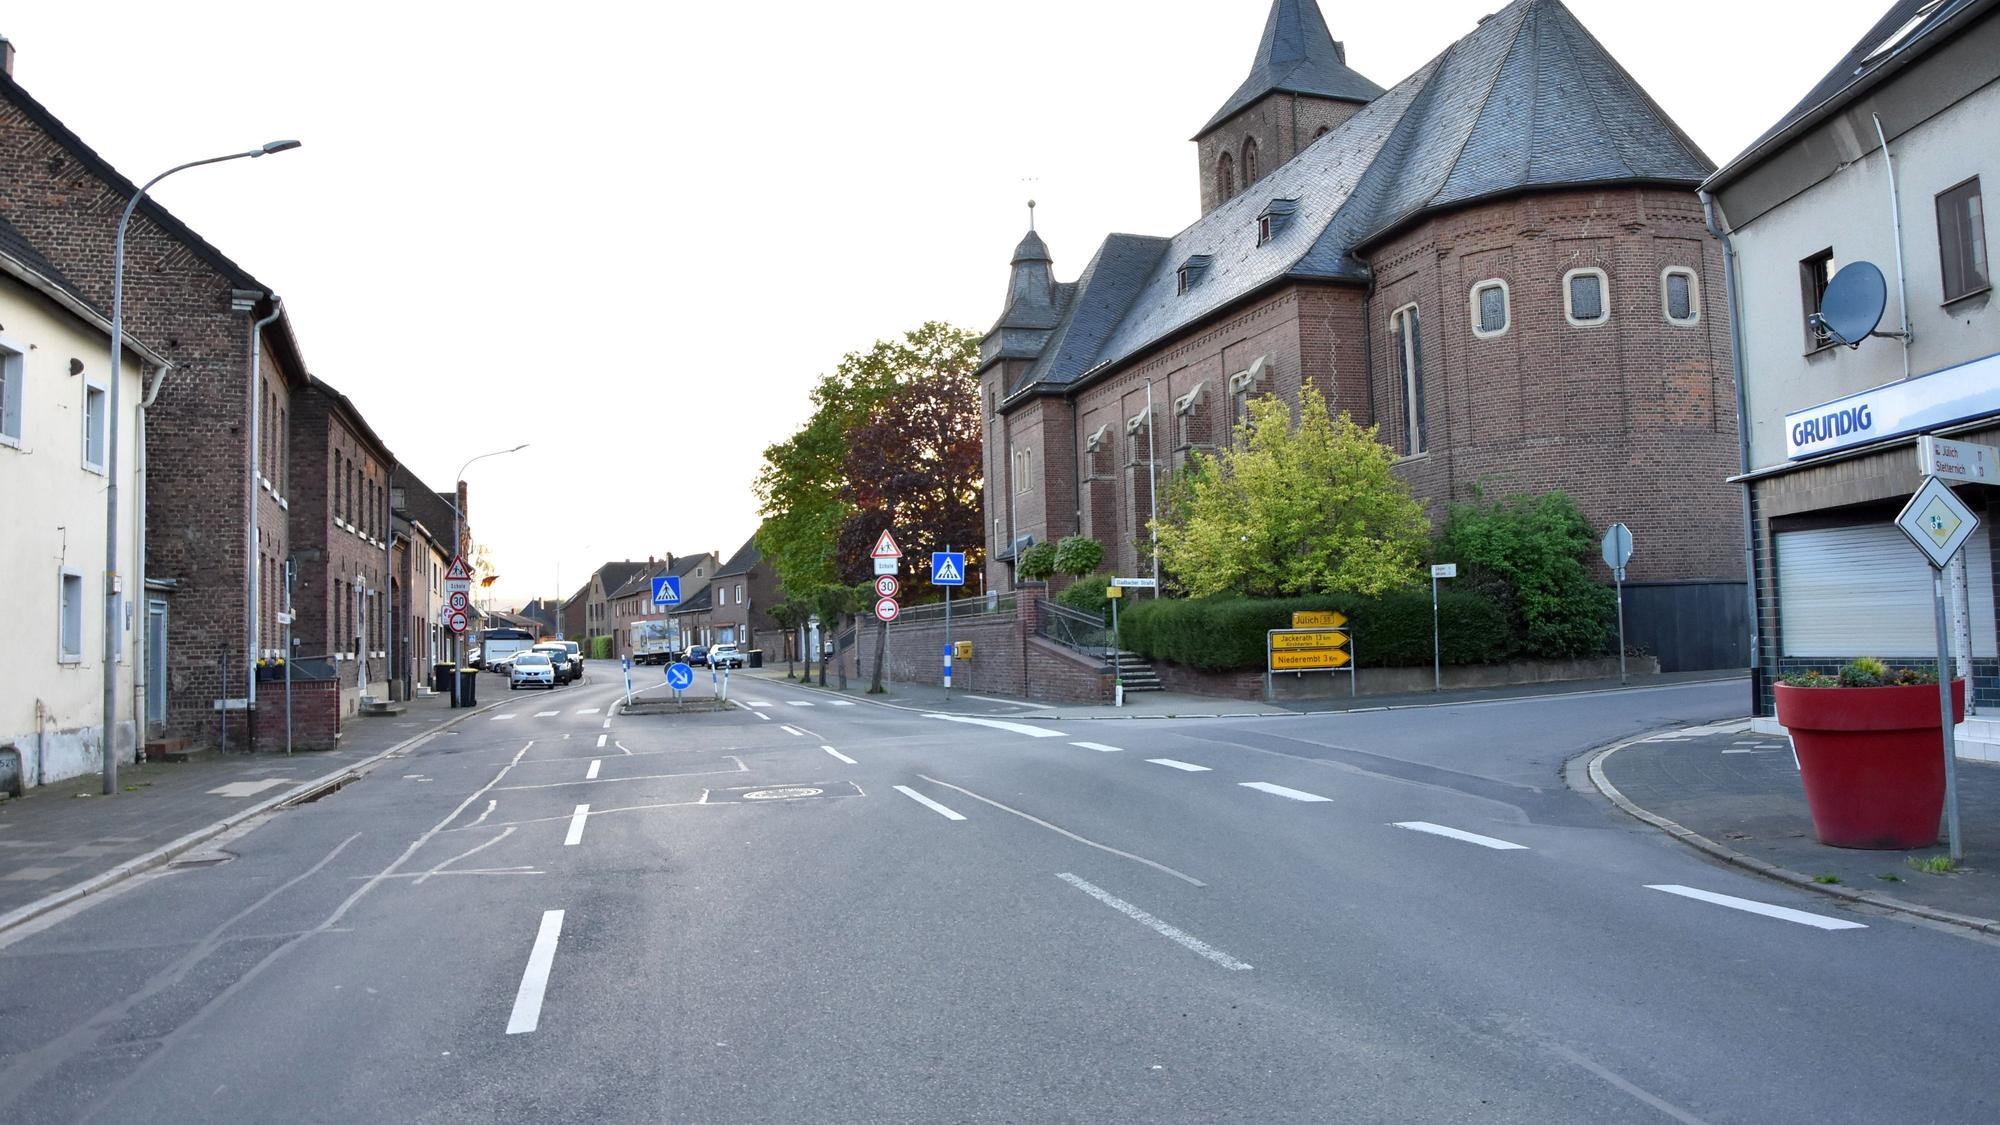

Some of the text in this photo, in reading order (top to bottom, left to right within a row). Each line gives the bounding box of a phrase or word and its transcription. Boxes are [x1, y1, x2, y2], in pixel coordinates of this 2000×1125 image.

[1792, 404, 1872, 447] GRUNDIG
[1942, 446, 1958, 458] Jülich
[1936, 461, 1965, 474] Stetternich
[880, 581, 893, 591] 30
[454, 597, 464, 606] 30
[1296, 615, 1318, 624] Jülich
[1281, 634, 1313, 642] Jackerath
[1323, 654, 1328, 662] 3
